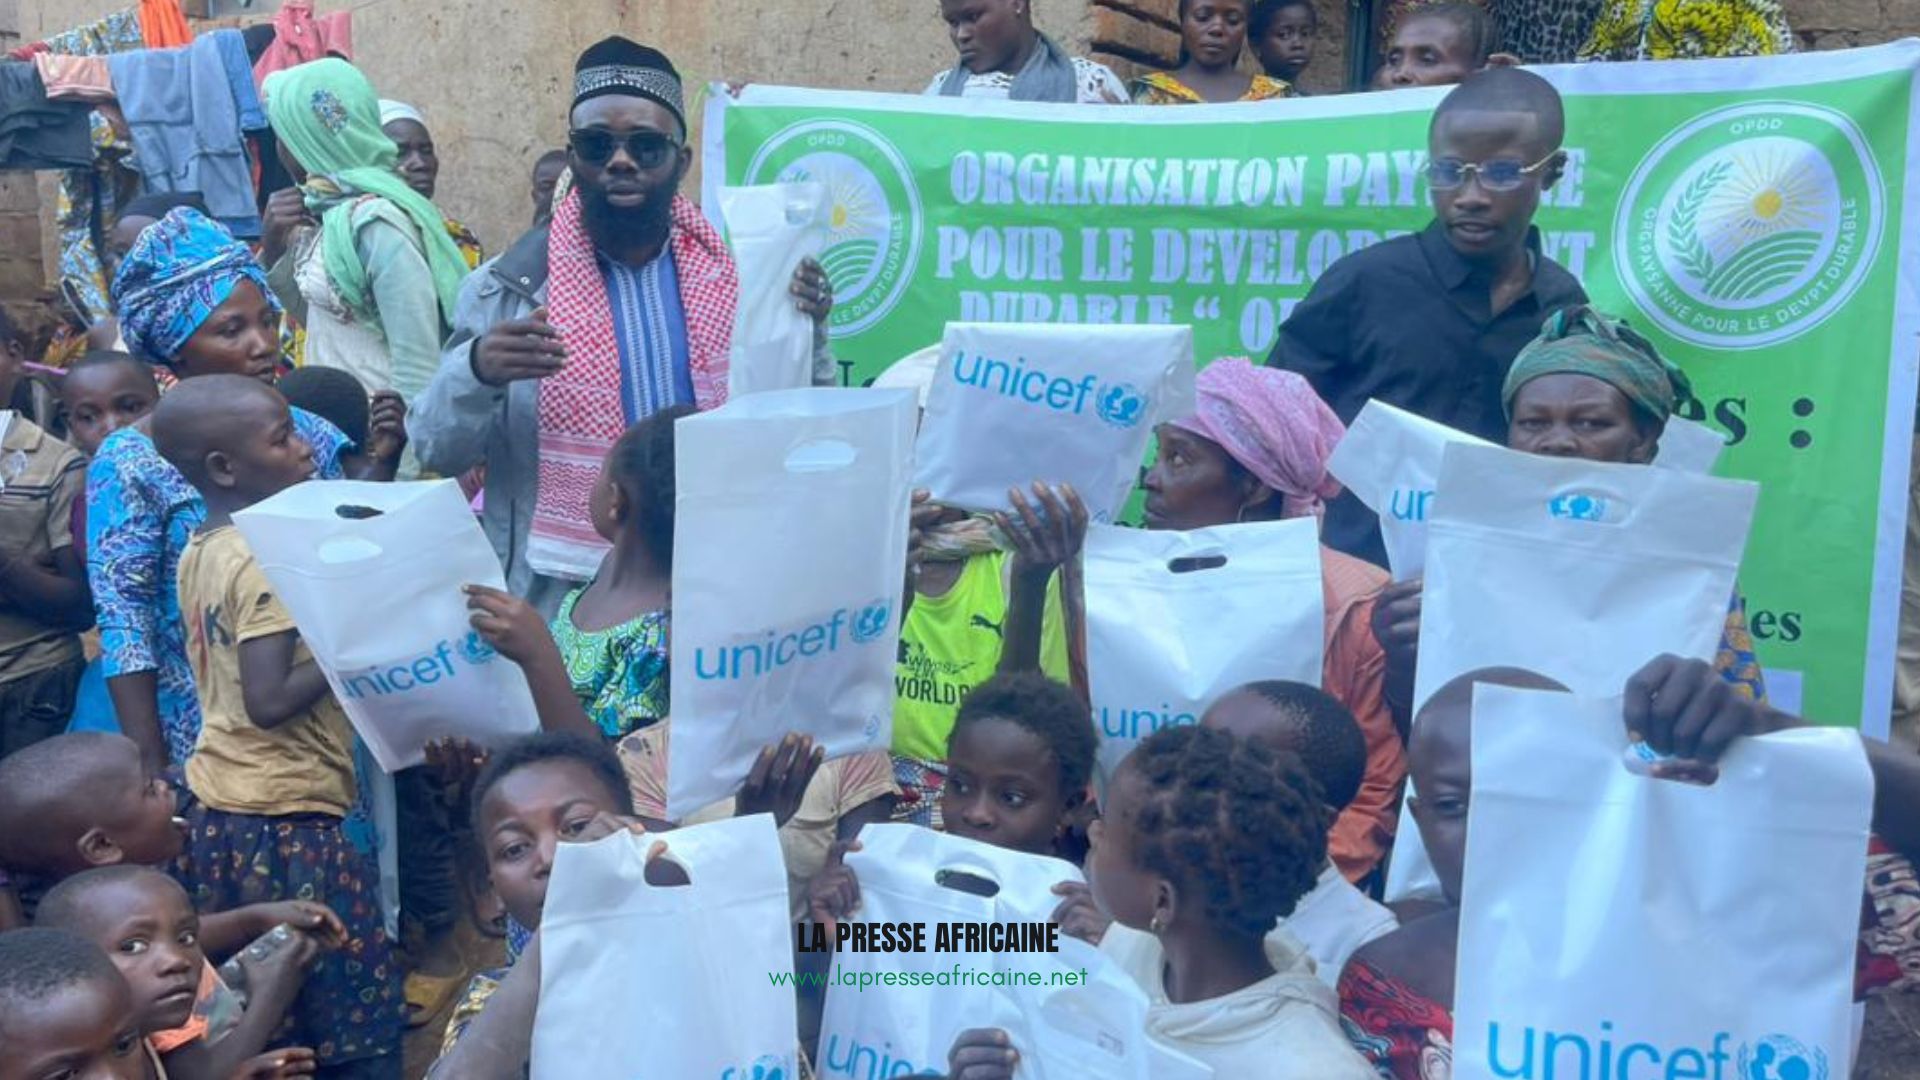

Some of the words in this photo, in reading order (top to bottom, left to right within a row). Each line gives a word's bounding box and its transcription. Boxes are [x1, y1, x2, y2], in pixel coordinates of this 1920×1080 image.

[950, 149, 1308, 208] ORGANISATION
[935, 225, 1064, 281] POUR
[1079, 227, 1135, 282] LE
[1746, 316, 1771, 332] LE
[952, 349, 1097, 415] unicef
[695, 608, 847, 680] unicef
[1488, 1020, 1732, 1080] unicef
